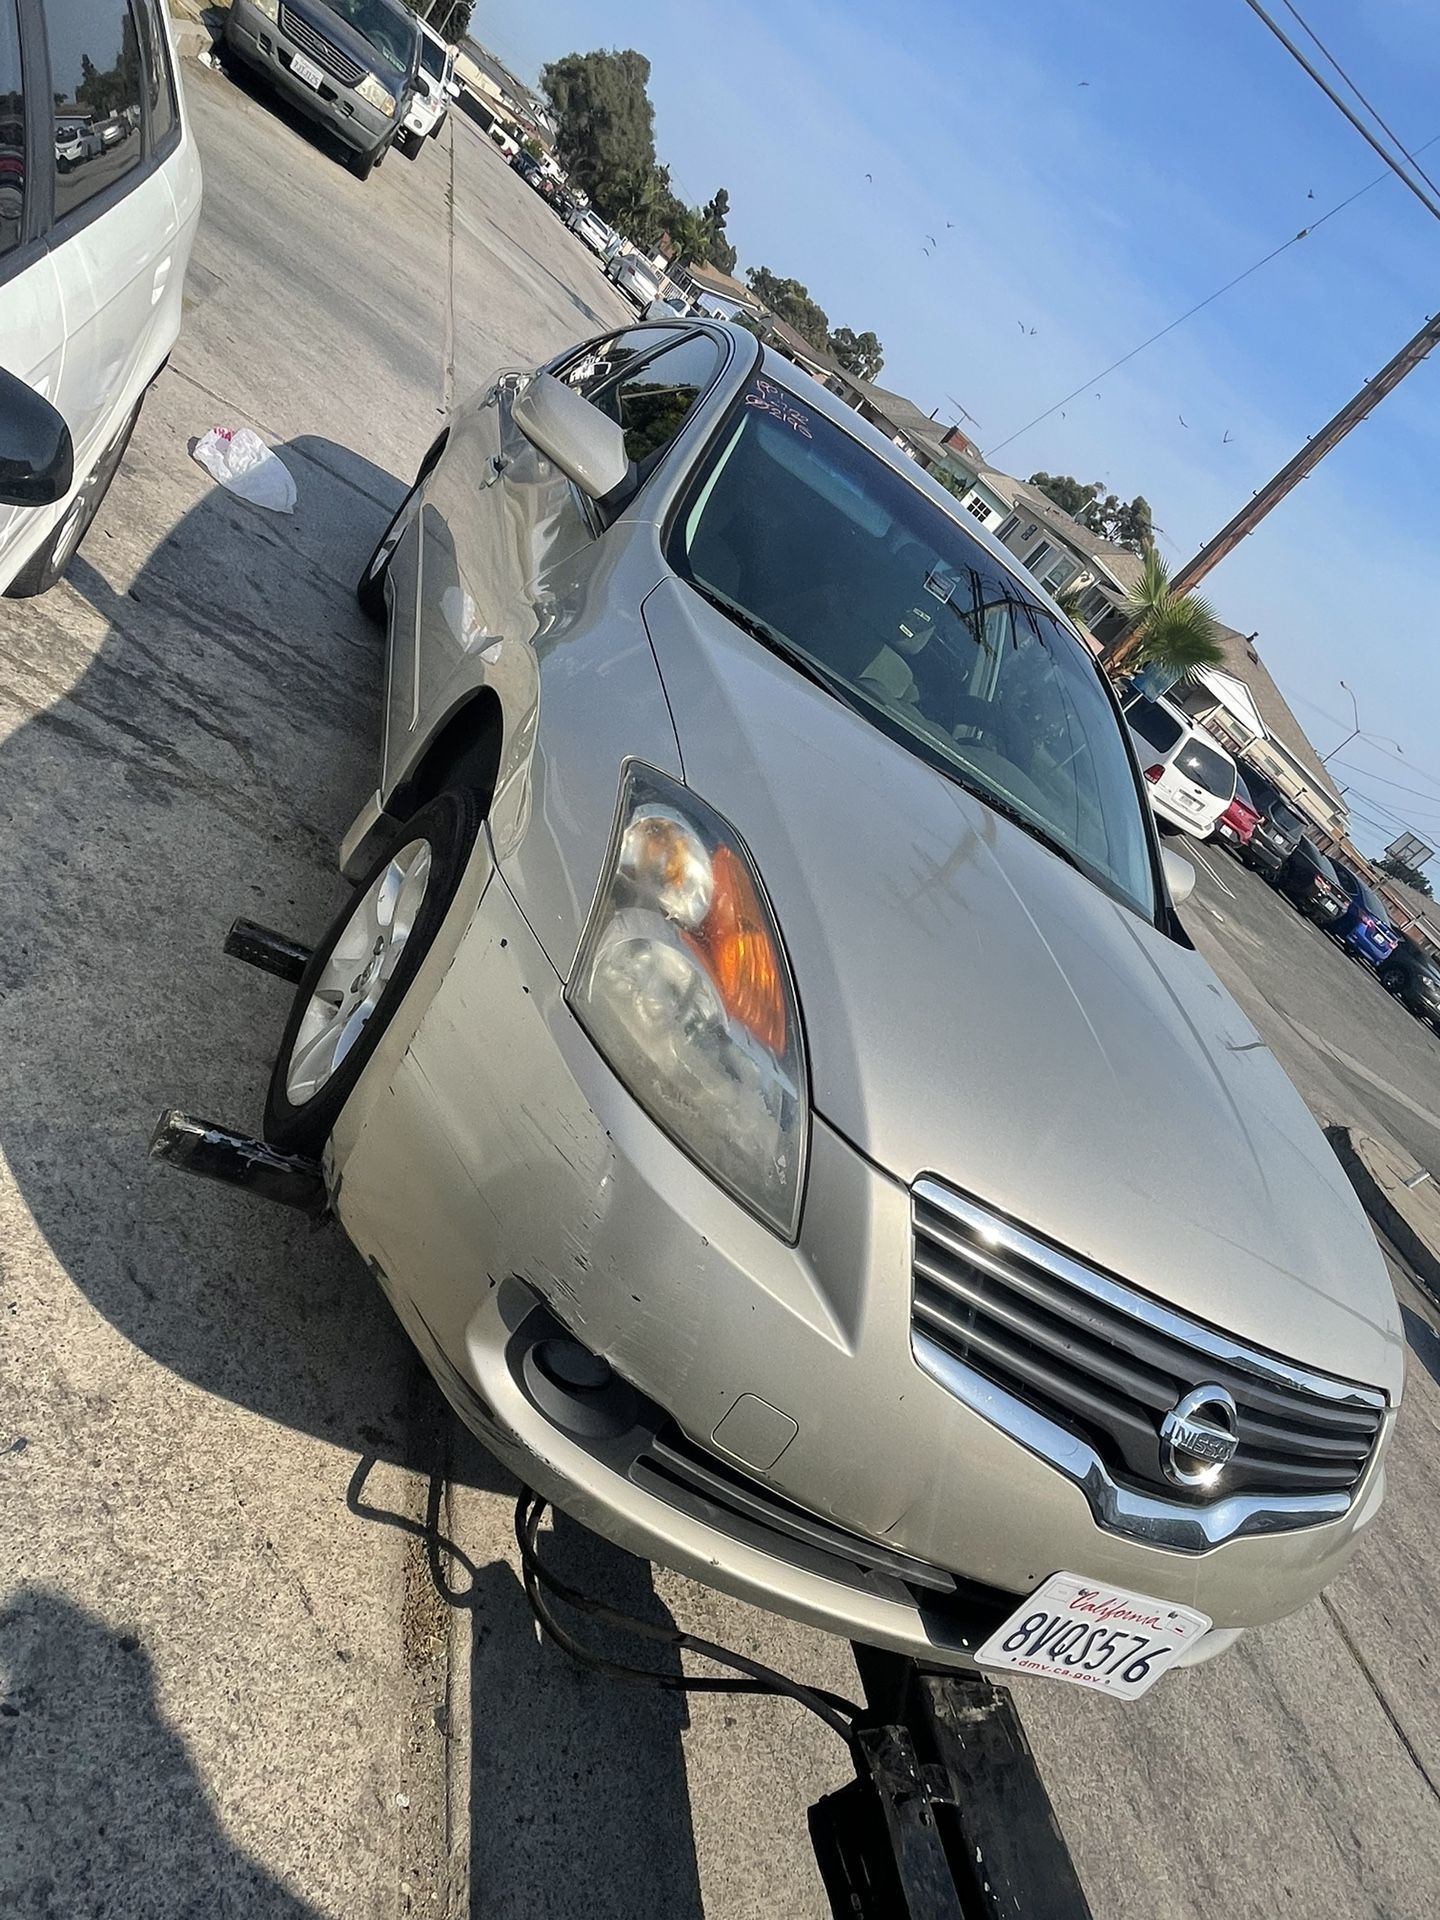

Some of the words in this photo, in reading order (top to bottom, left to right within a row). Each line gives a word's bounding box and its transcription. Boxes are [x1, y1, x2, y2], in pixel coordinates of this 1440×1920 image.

[1069, 1591, 1163, 1631] California
[1002, 1612, 1172, 1684] 8VQS576
[1018, 1659, 1102, 1685] dmv.ca.gov
